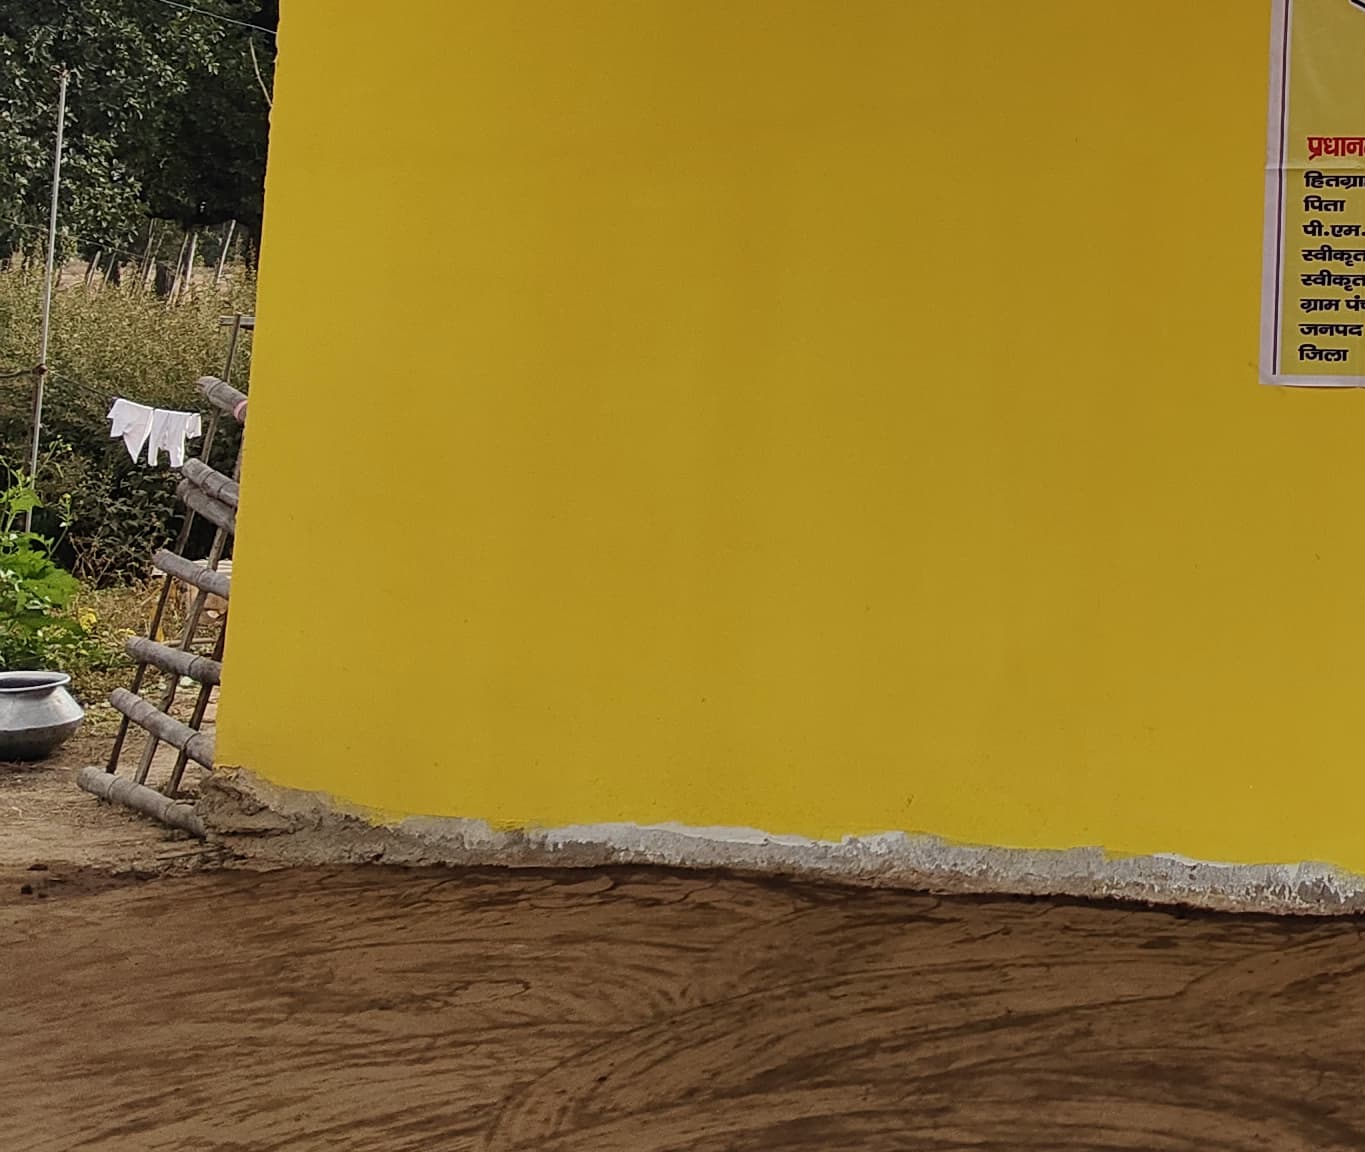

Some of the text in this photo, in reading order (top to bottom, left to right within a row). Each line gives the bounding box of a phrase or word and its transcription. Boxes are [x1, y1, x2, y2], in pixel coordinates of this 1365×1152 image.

[1303, 195, 1346, 212] पिता
[1300, 299, 1341, 313] ग्राम
[1298, 323, 1364, 337] जनपद
[1298, 344, 1349, 362] जिला
